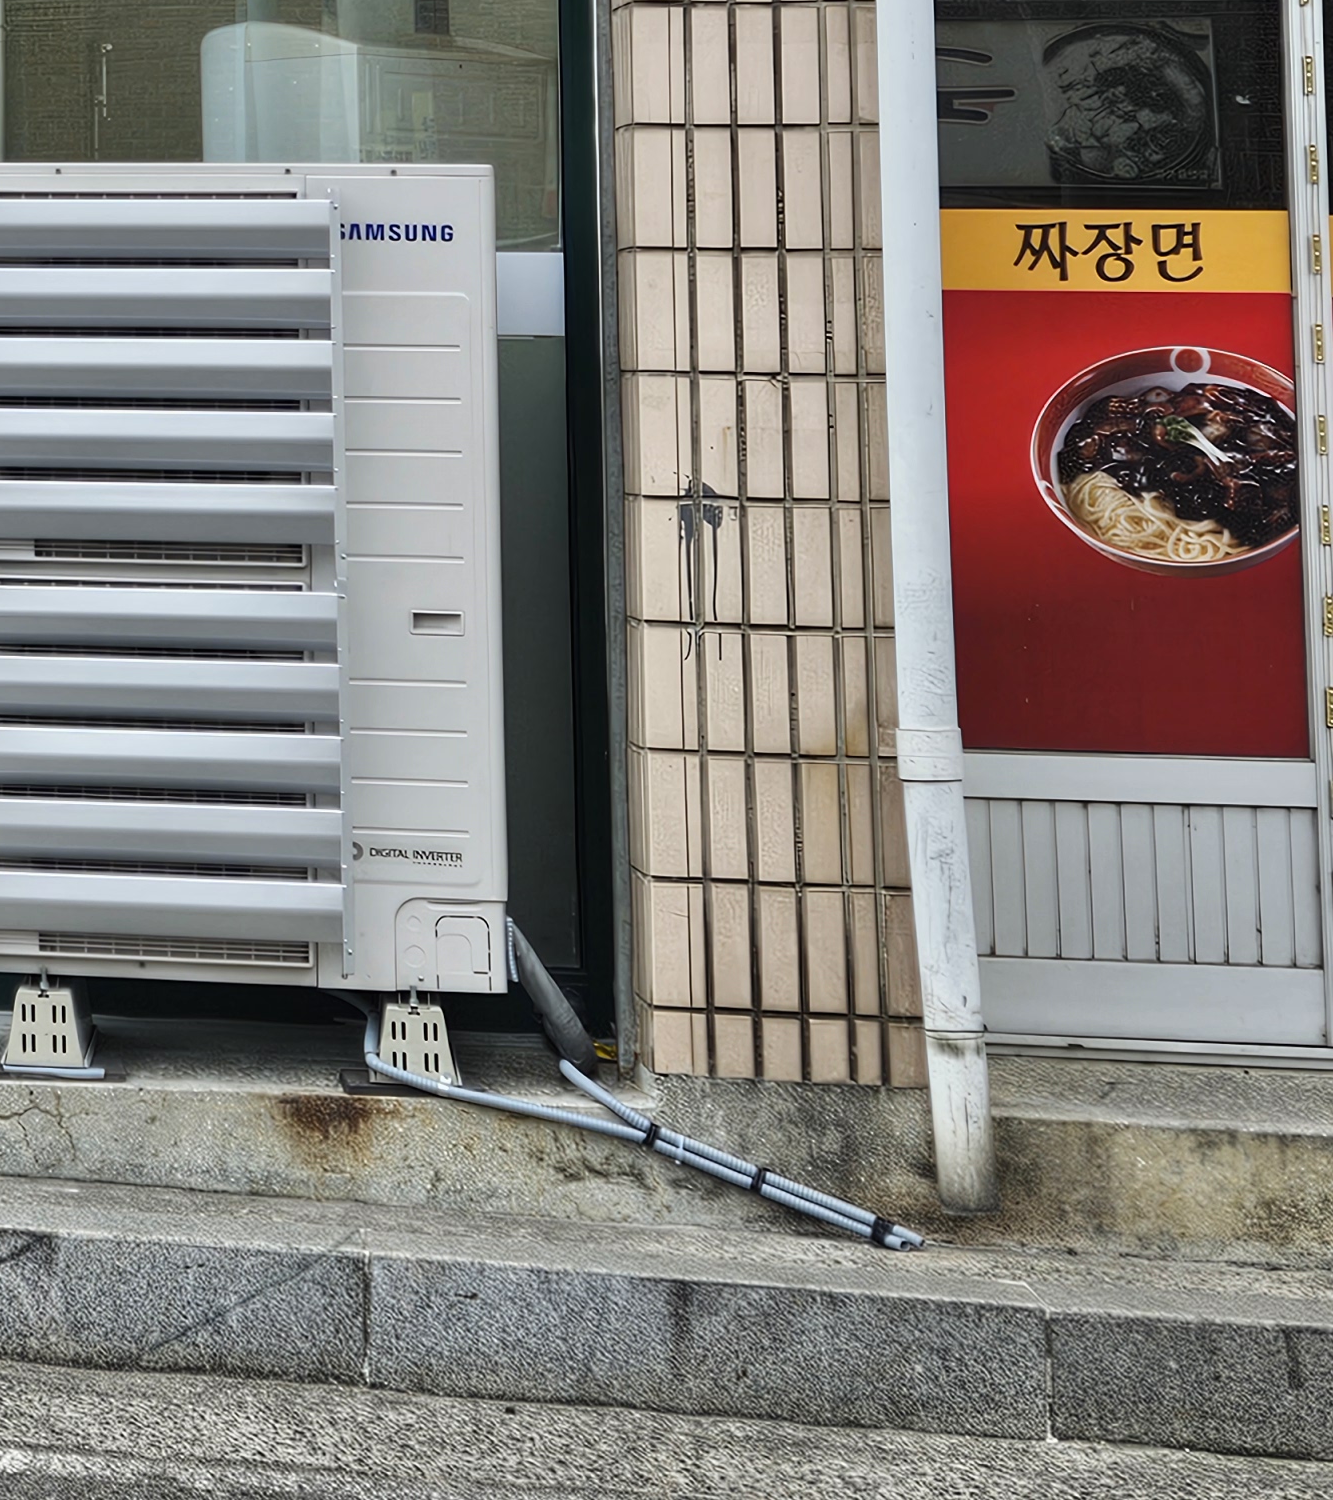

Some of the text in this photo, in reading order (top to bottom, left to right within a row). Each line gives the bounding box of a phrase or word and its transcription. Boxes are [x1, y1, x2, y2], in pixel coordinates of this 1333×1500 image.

[1013, 220, 1204, 283] 짜장면
[369, 847, 463, 862] DIGITAL INVERTER
